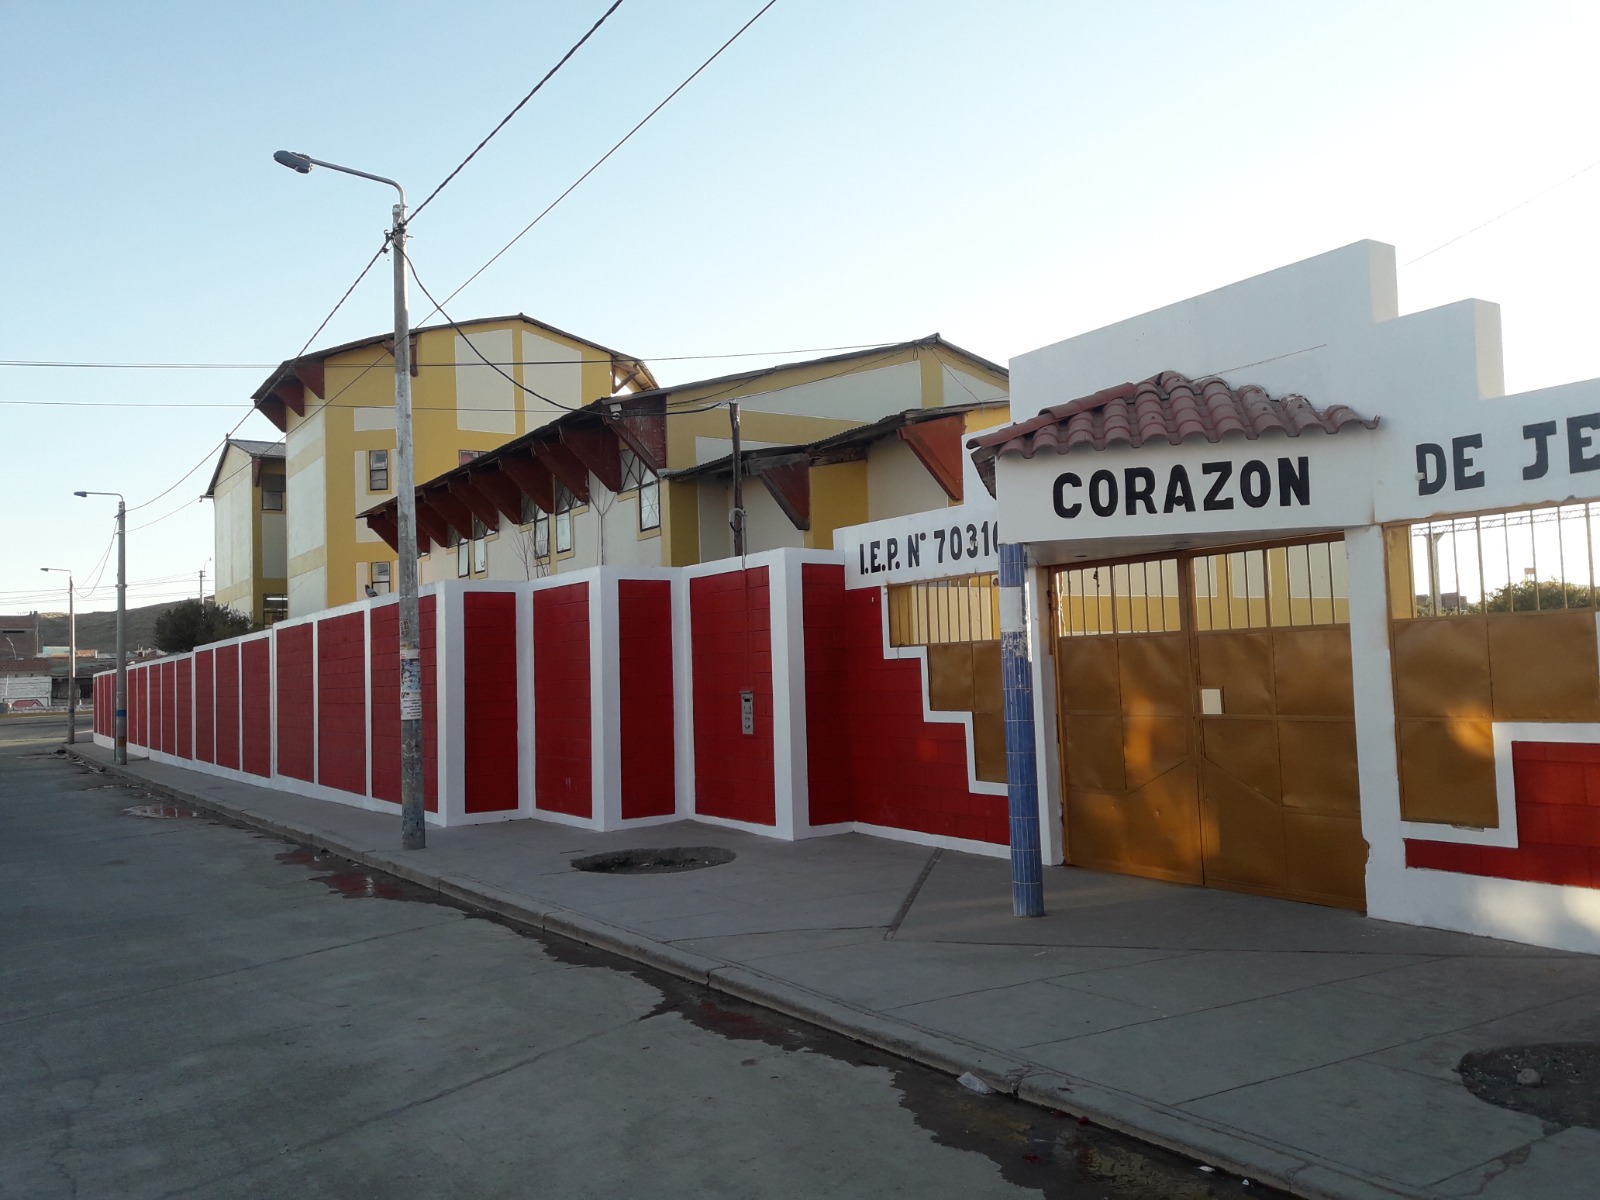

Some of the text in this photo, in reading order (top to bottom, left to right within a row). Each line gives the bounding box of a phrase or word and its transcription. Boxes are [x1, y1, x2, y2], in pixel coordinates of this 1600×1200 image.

[1052, 456, 1311, 519] CORAZON
[1415, 433, 1485, 496] DE
[860, 537, 900, 575] I.E.P.
